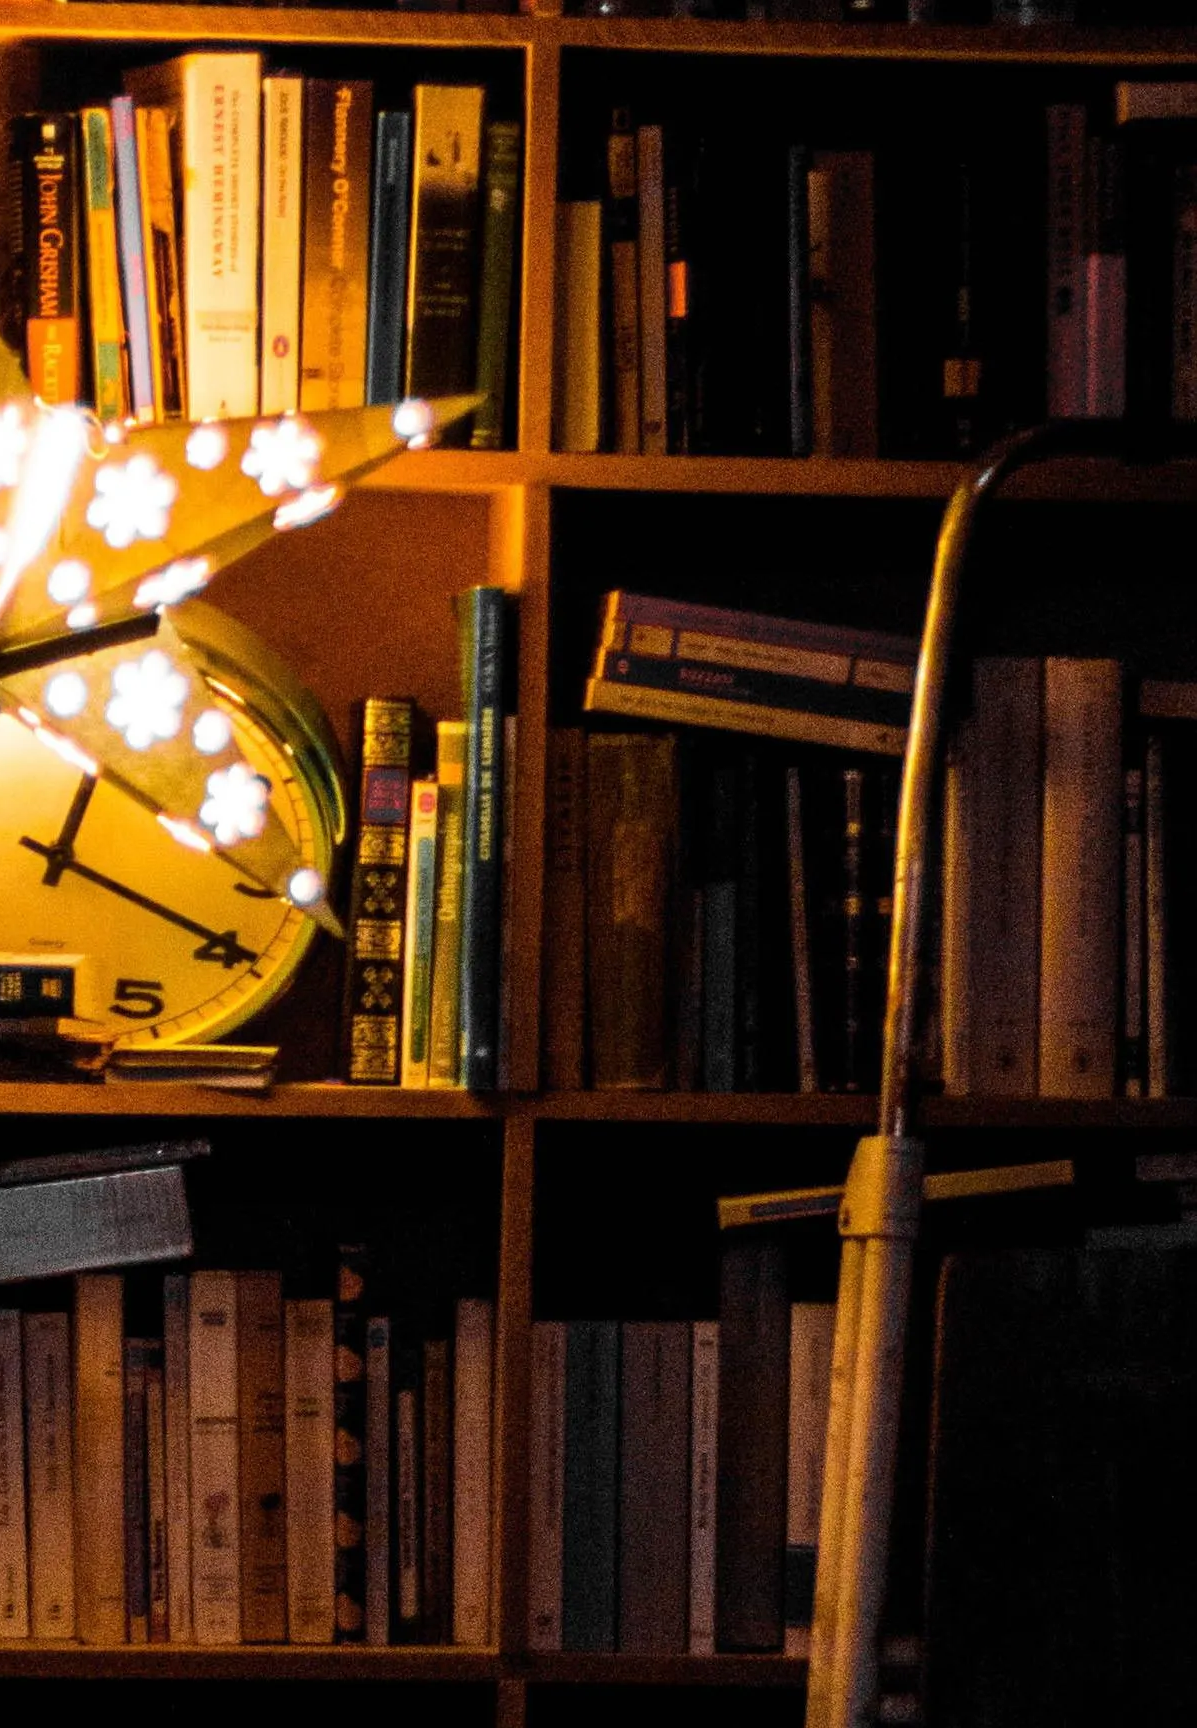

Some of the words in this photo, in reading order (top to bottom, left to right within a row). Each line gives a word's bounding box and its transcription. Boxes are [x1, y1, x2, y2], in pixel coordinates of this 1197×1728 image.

[211, 83, 226, 155] ERNEST
[329, 87, 353, 172] Flannery
[38, 173, 62, 222] JOHN
[211, 164, 225, 280] HEMINGWAY
[329, 178, 350, 269] O'Connor
[37, 227, 65, 318] GRISHAM
[479, 706, 495, 766] LUMIÈRE
[480, 770, 492, 788] DE
[479, 793, 492, 861] CITADELLE
[193, 928, 258, 970] 4
[108, 978, 166, 1020] 5
